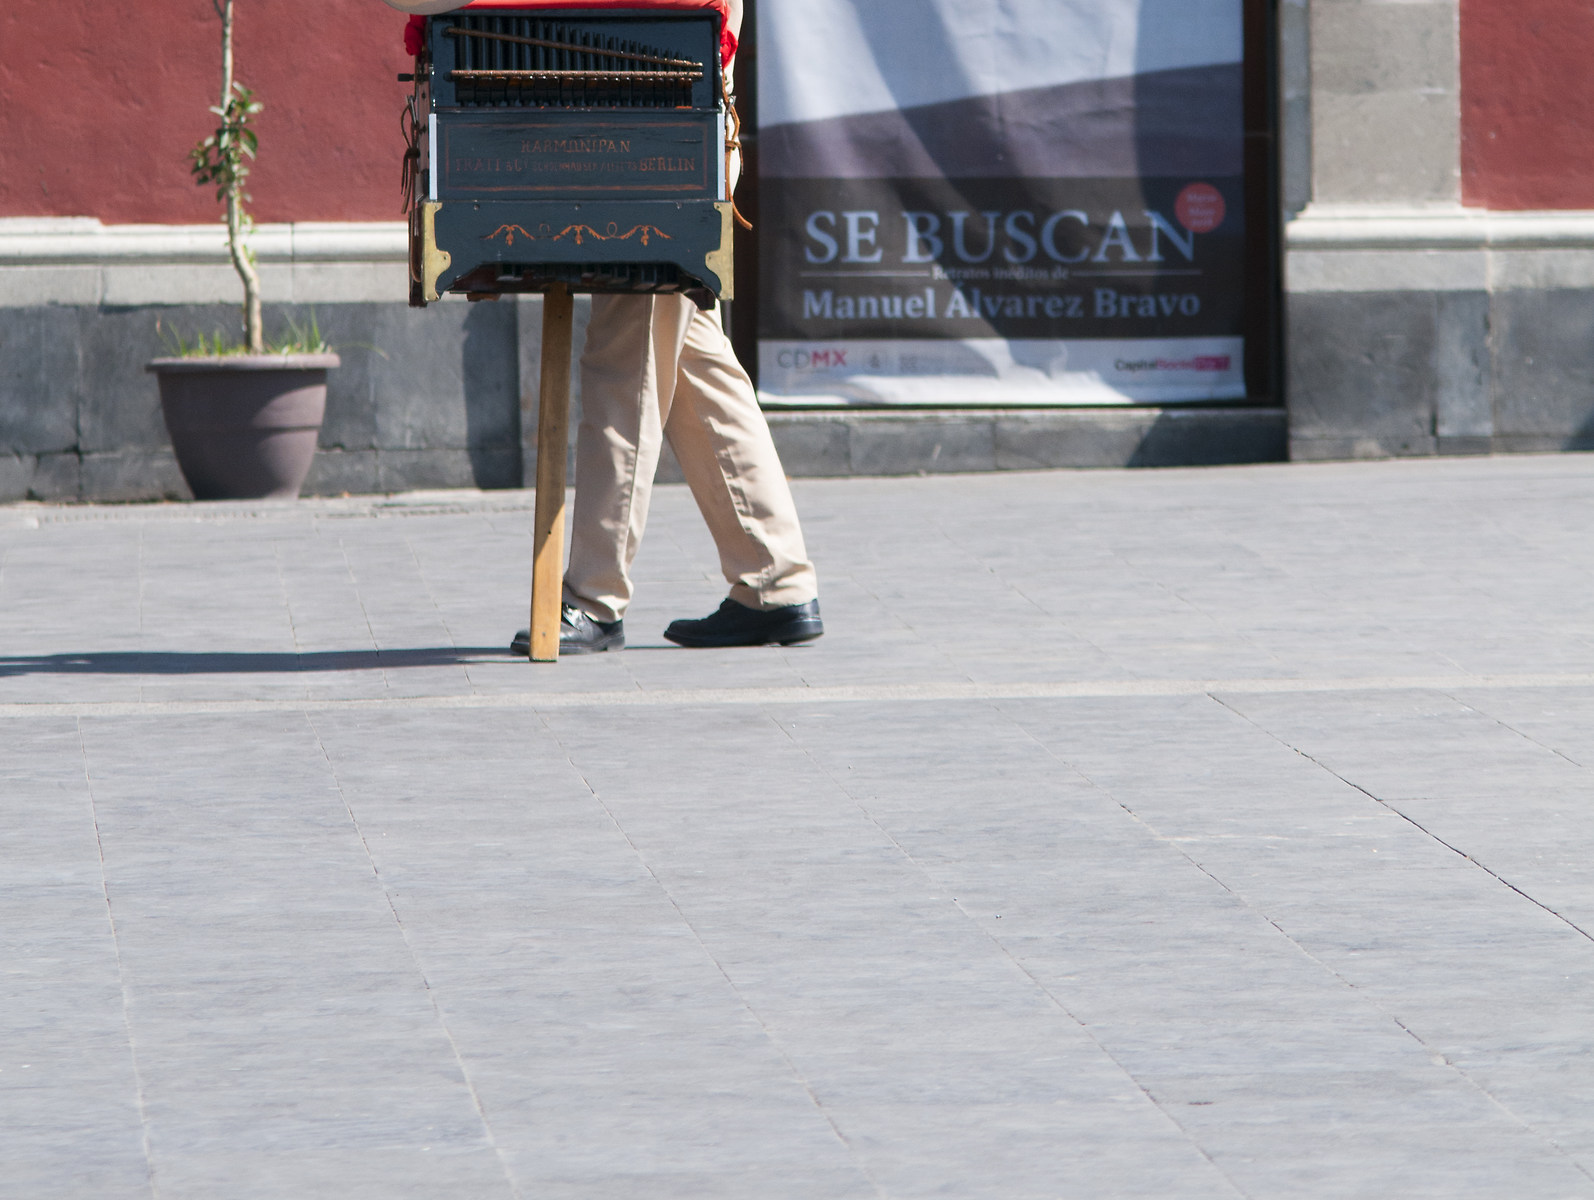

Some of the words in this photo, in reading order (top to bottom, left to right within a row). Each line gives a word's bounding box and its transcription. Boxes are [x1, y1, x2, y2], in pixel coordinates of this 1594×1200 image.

[639, 156, 696, 172] BERLIN
[804, 210, 884, 264] SE
[901, 209, 1196, 264] BUSCAN
[932, 265, 991, 280] Retratos
[1051, 264, 1070, 280] de
[803, 288, 936, 320] Manuel
[944, 281, 1083, 318] Álvarez
[1093, 289, 1200, 317] Bravo
[777, 350, 848, 369] CDMX
